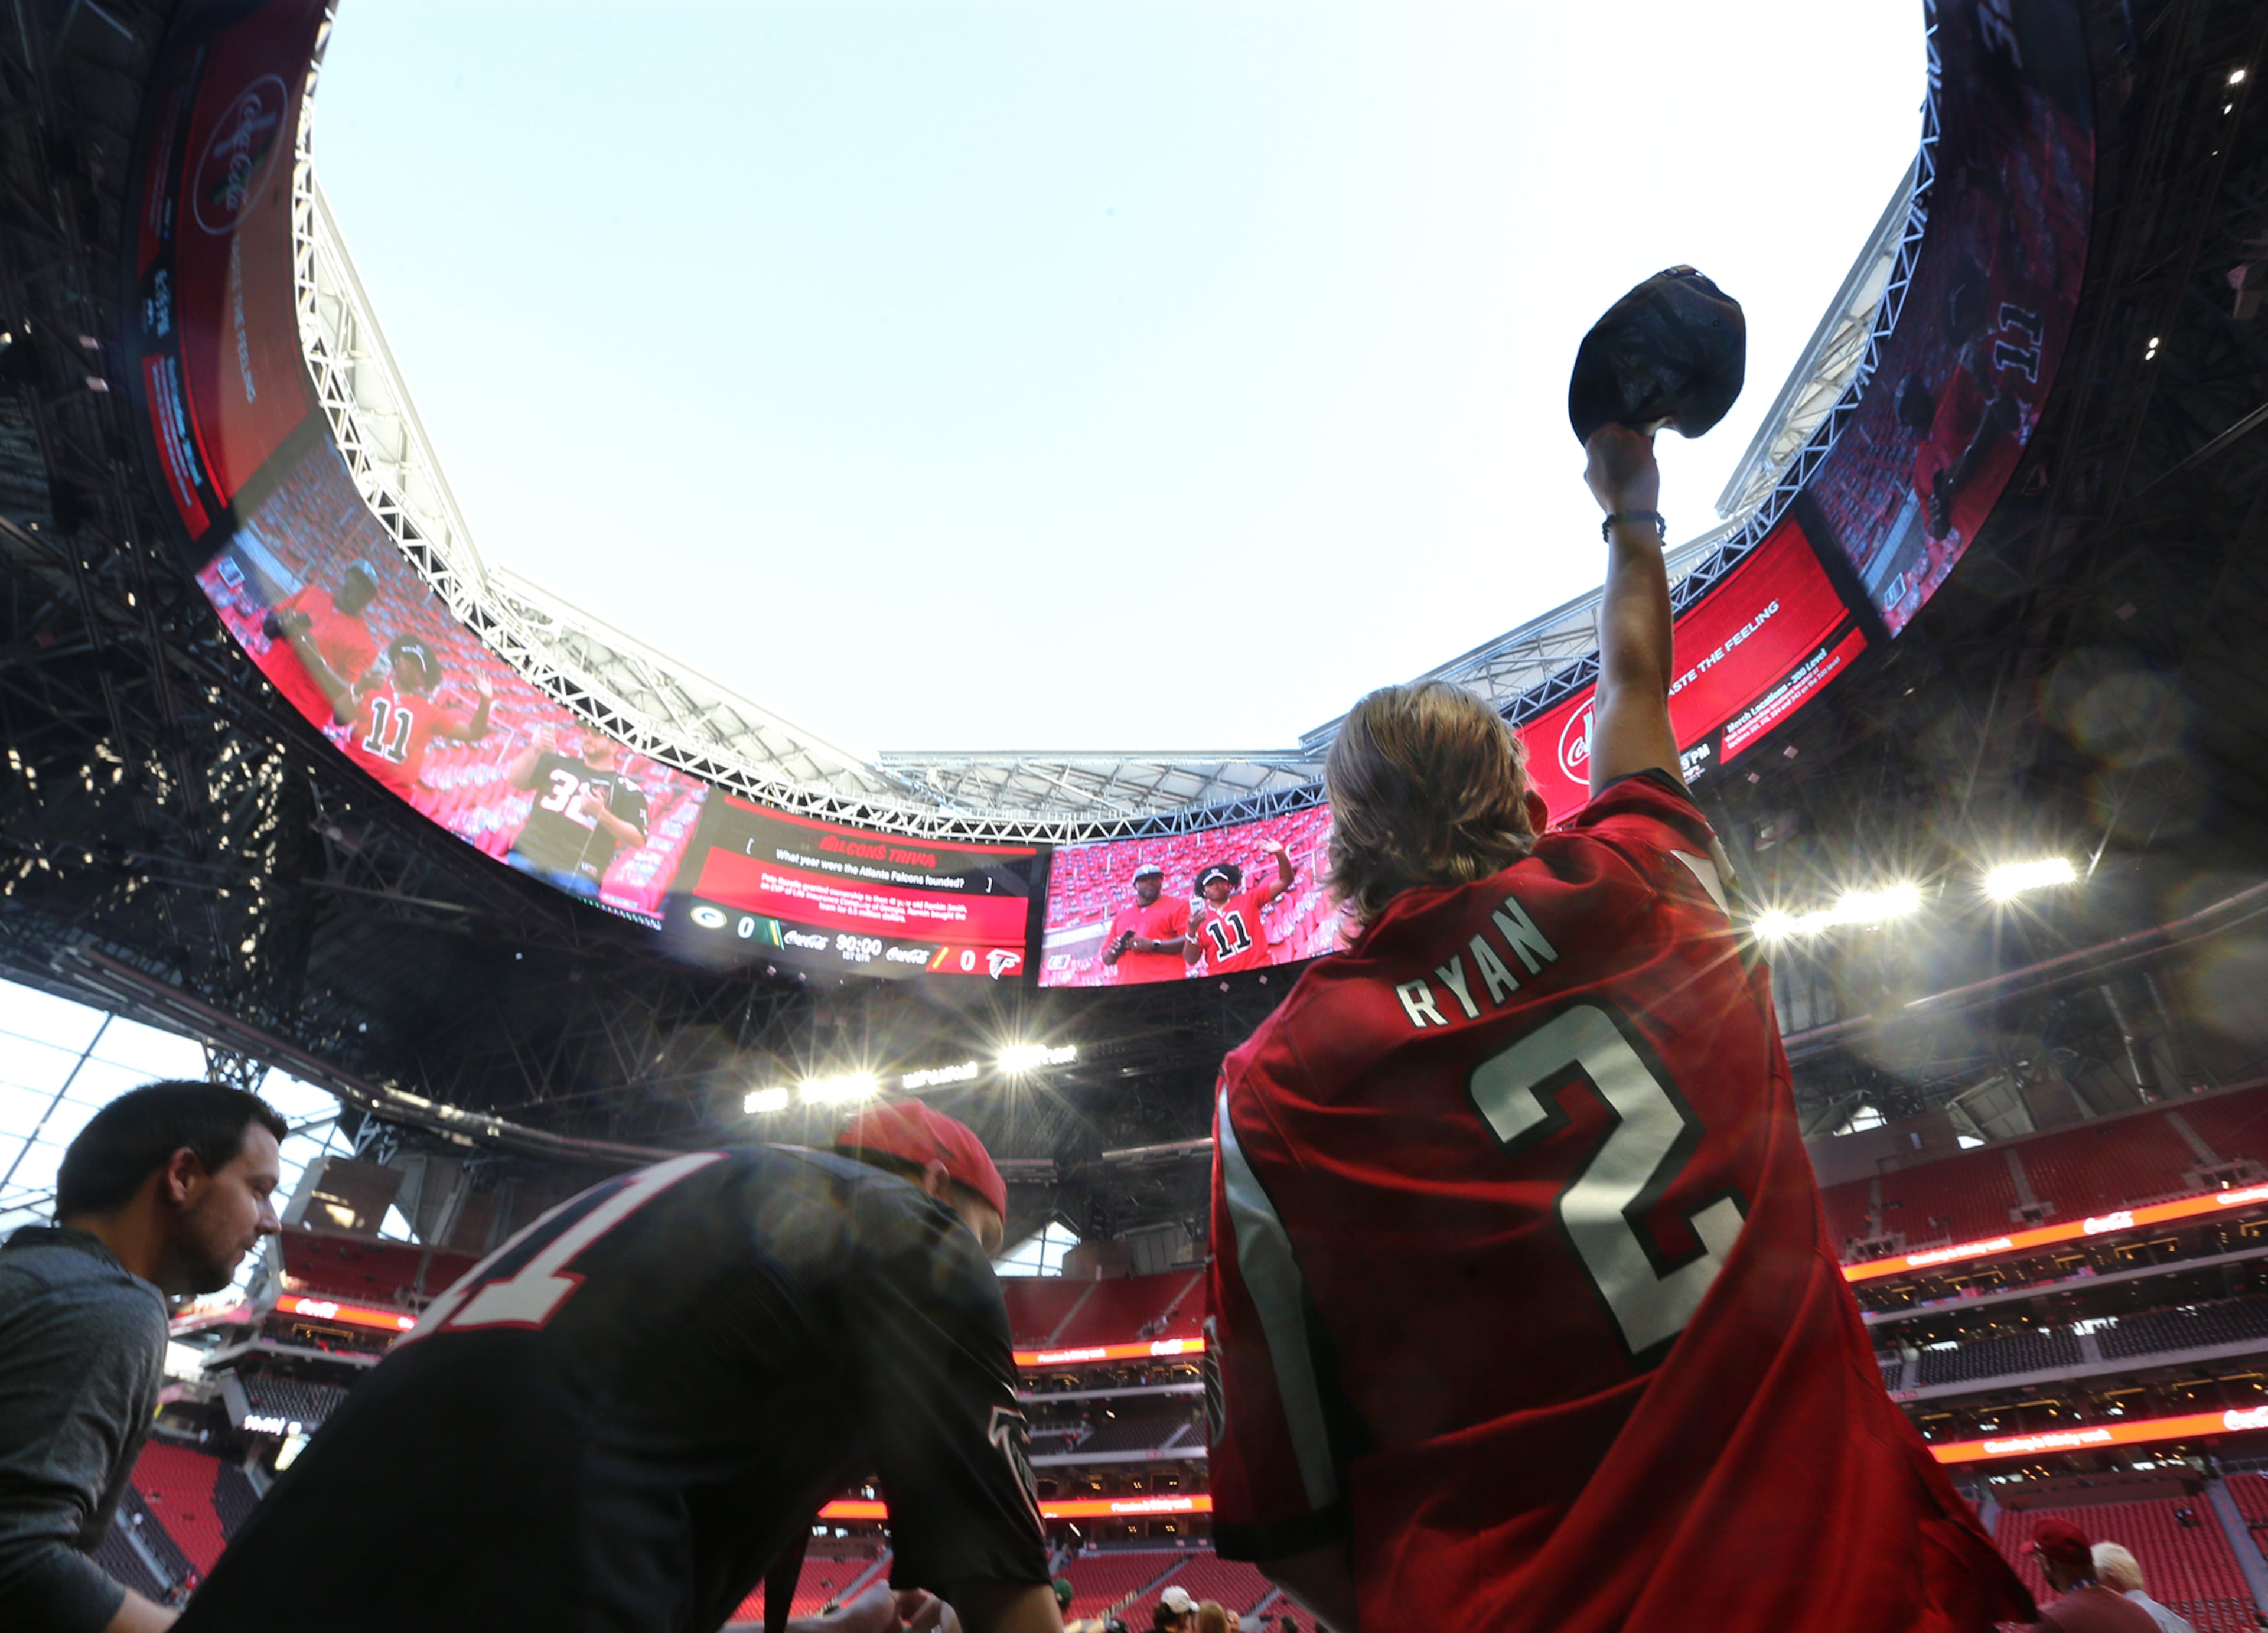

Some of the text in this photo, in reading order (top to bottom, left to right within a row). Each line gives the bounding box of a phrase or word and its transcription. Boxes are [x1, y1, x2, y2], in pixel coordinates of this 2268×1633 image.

[1669, 600, 1780, 696] ASTE THE FEELING
[1726, 712, 1752, 733] Merch
[1750, 683, 1788, 716] Locations
[1805, 648, 1827, 672] Level
[363, 698, 413, 765] 11
[1691, 743, 1710, 764] PM
[776, 848, 965, 888] What year were the Atlanta Falcons founded?
[737, 916, 755, 939] 0
[836, 934, 882, 956] 90:00
[960, 950, 975, 971] 0
[1206, 910, 1253, 963] 11
[1394, 895, 1559, 1029] RYAN
[1465, 997, 1751, 1363] 2
